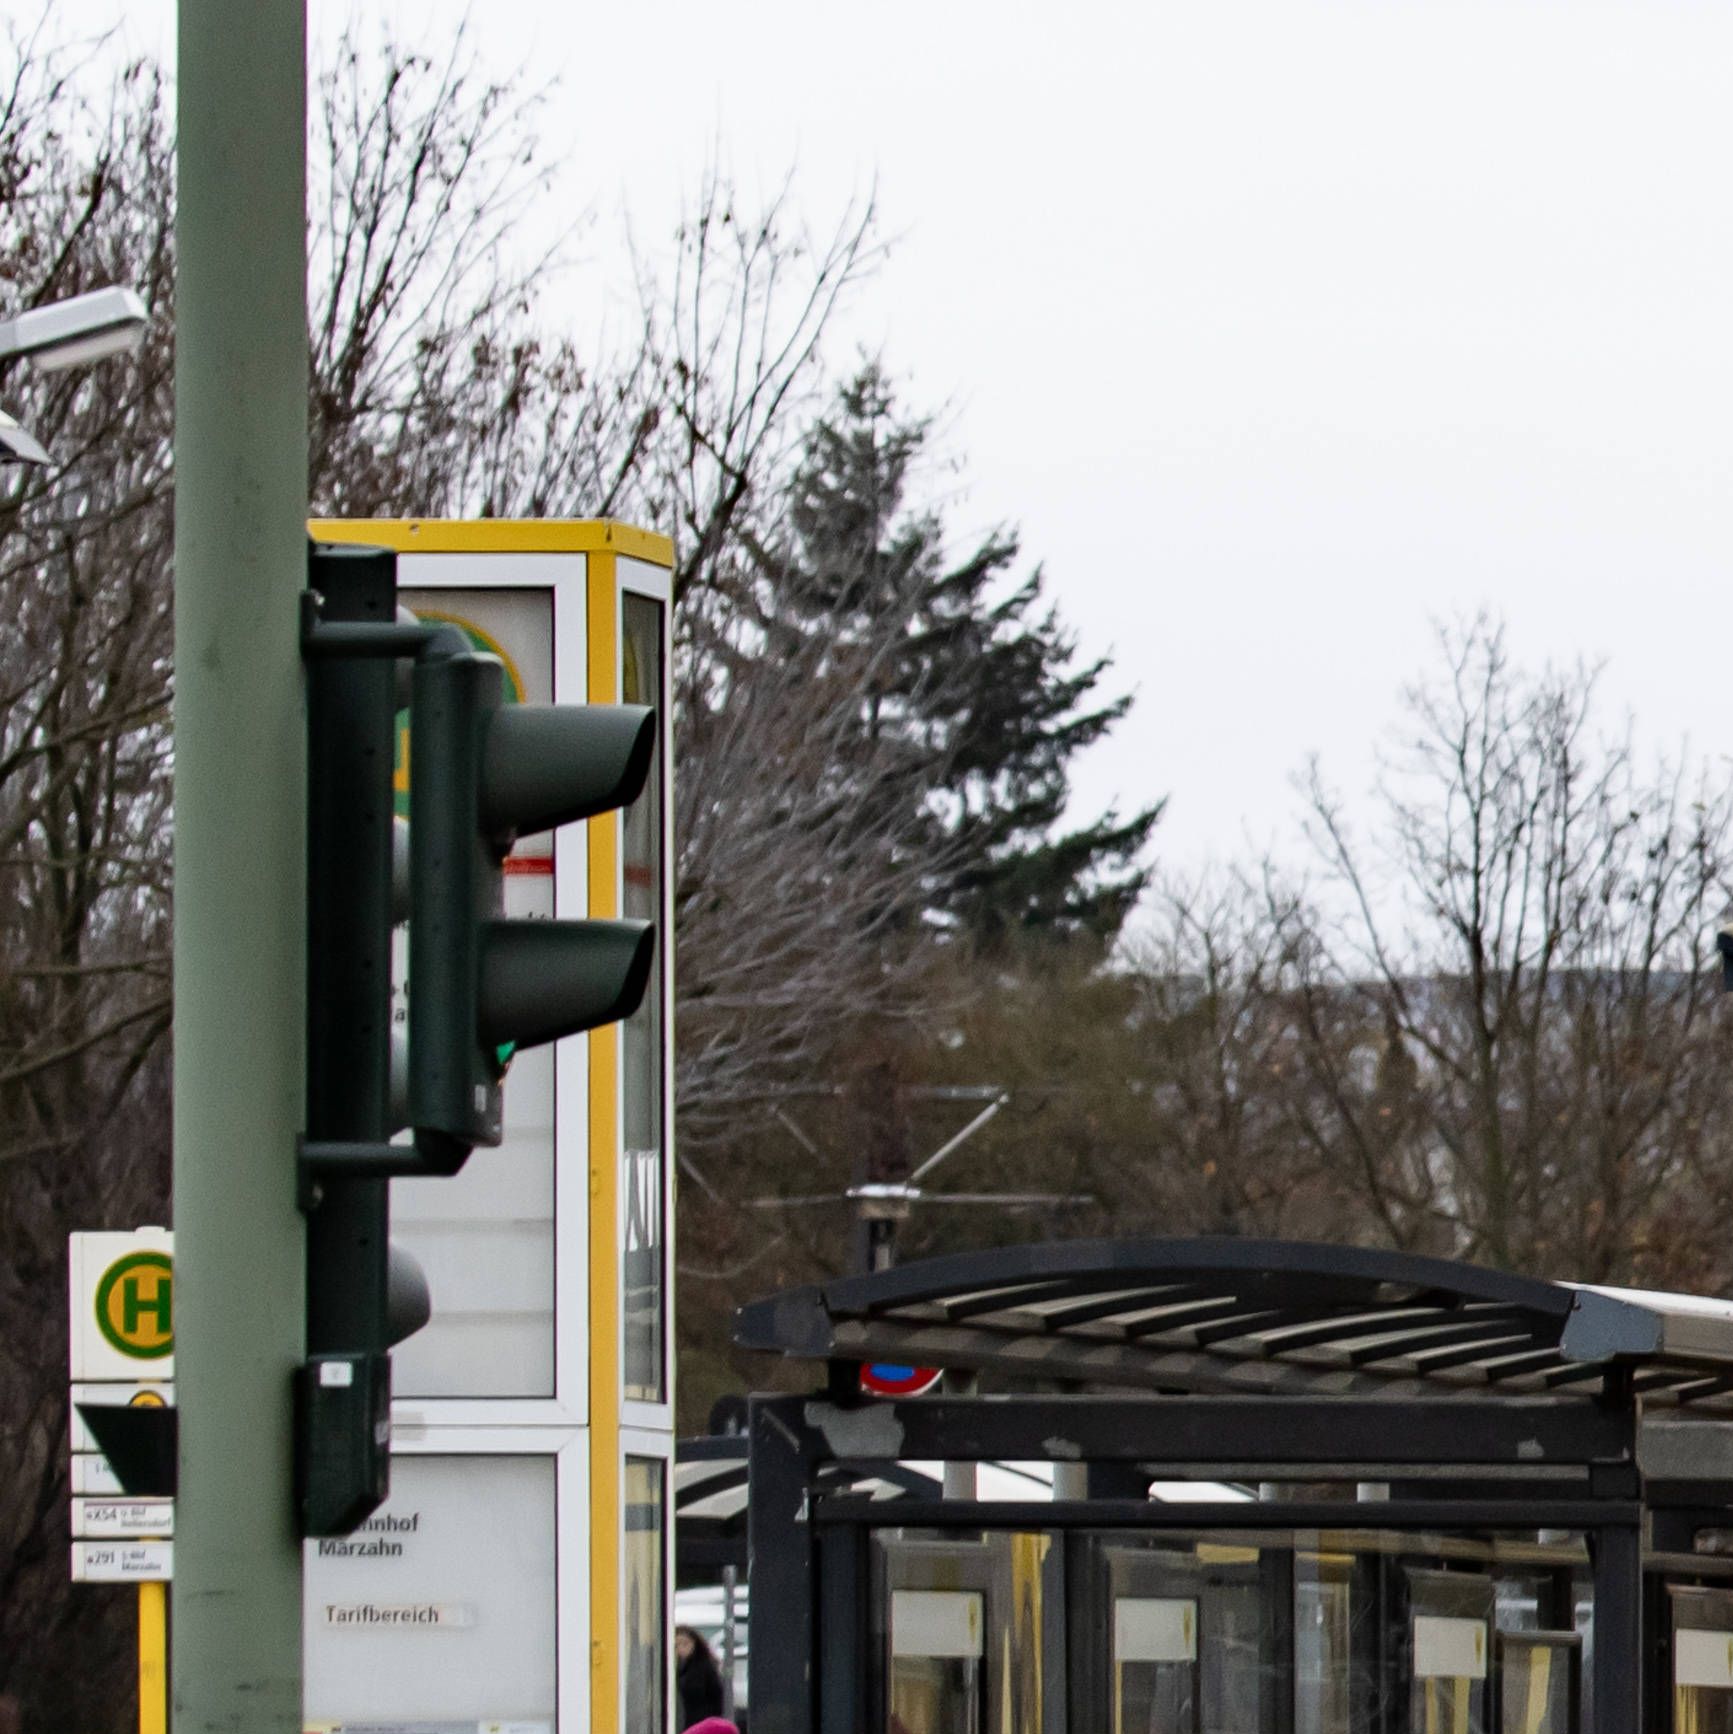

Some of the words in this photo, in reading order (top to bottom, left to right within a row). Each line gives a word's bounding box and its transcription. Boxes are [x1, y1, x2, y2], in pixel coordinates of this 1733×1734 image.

[123, 1278, 172, 1333] H
[318, 1537, 403, 1557] Marzahn
[326, 1604, 439, 1623] Tarifbereich
